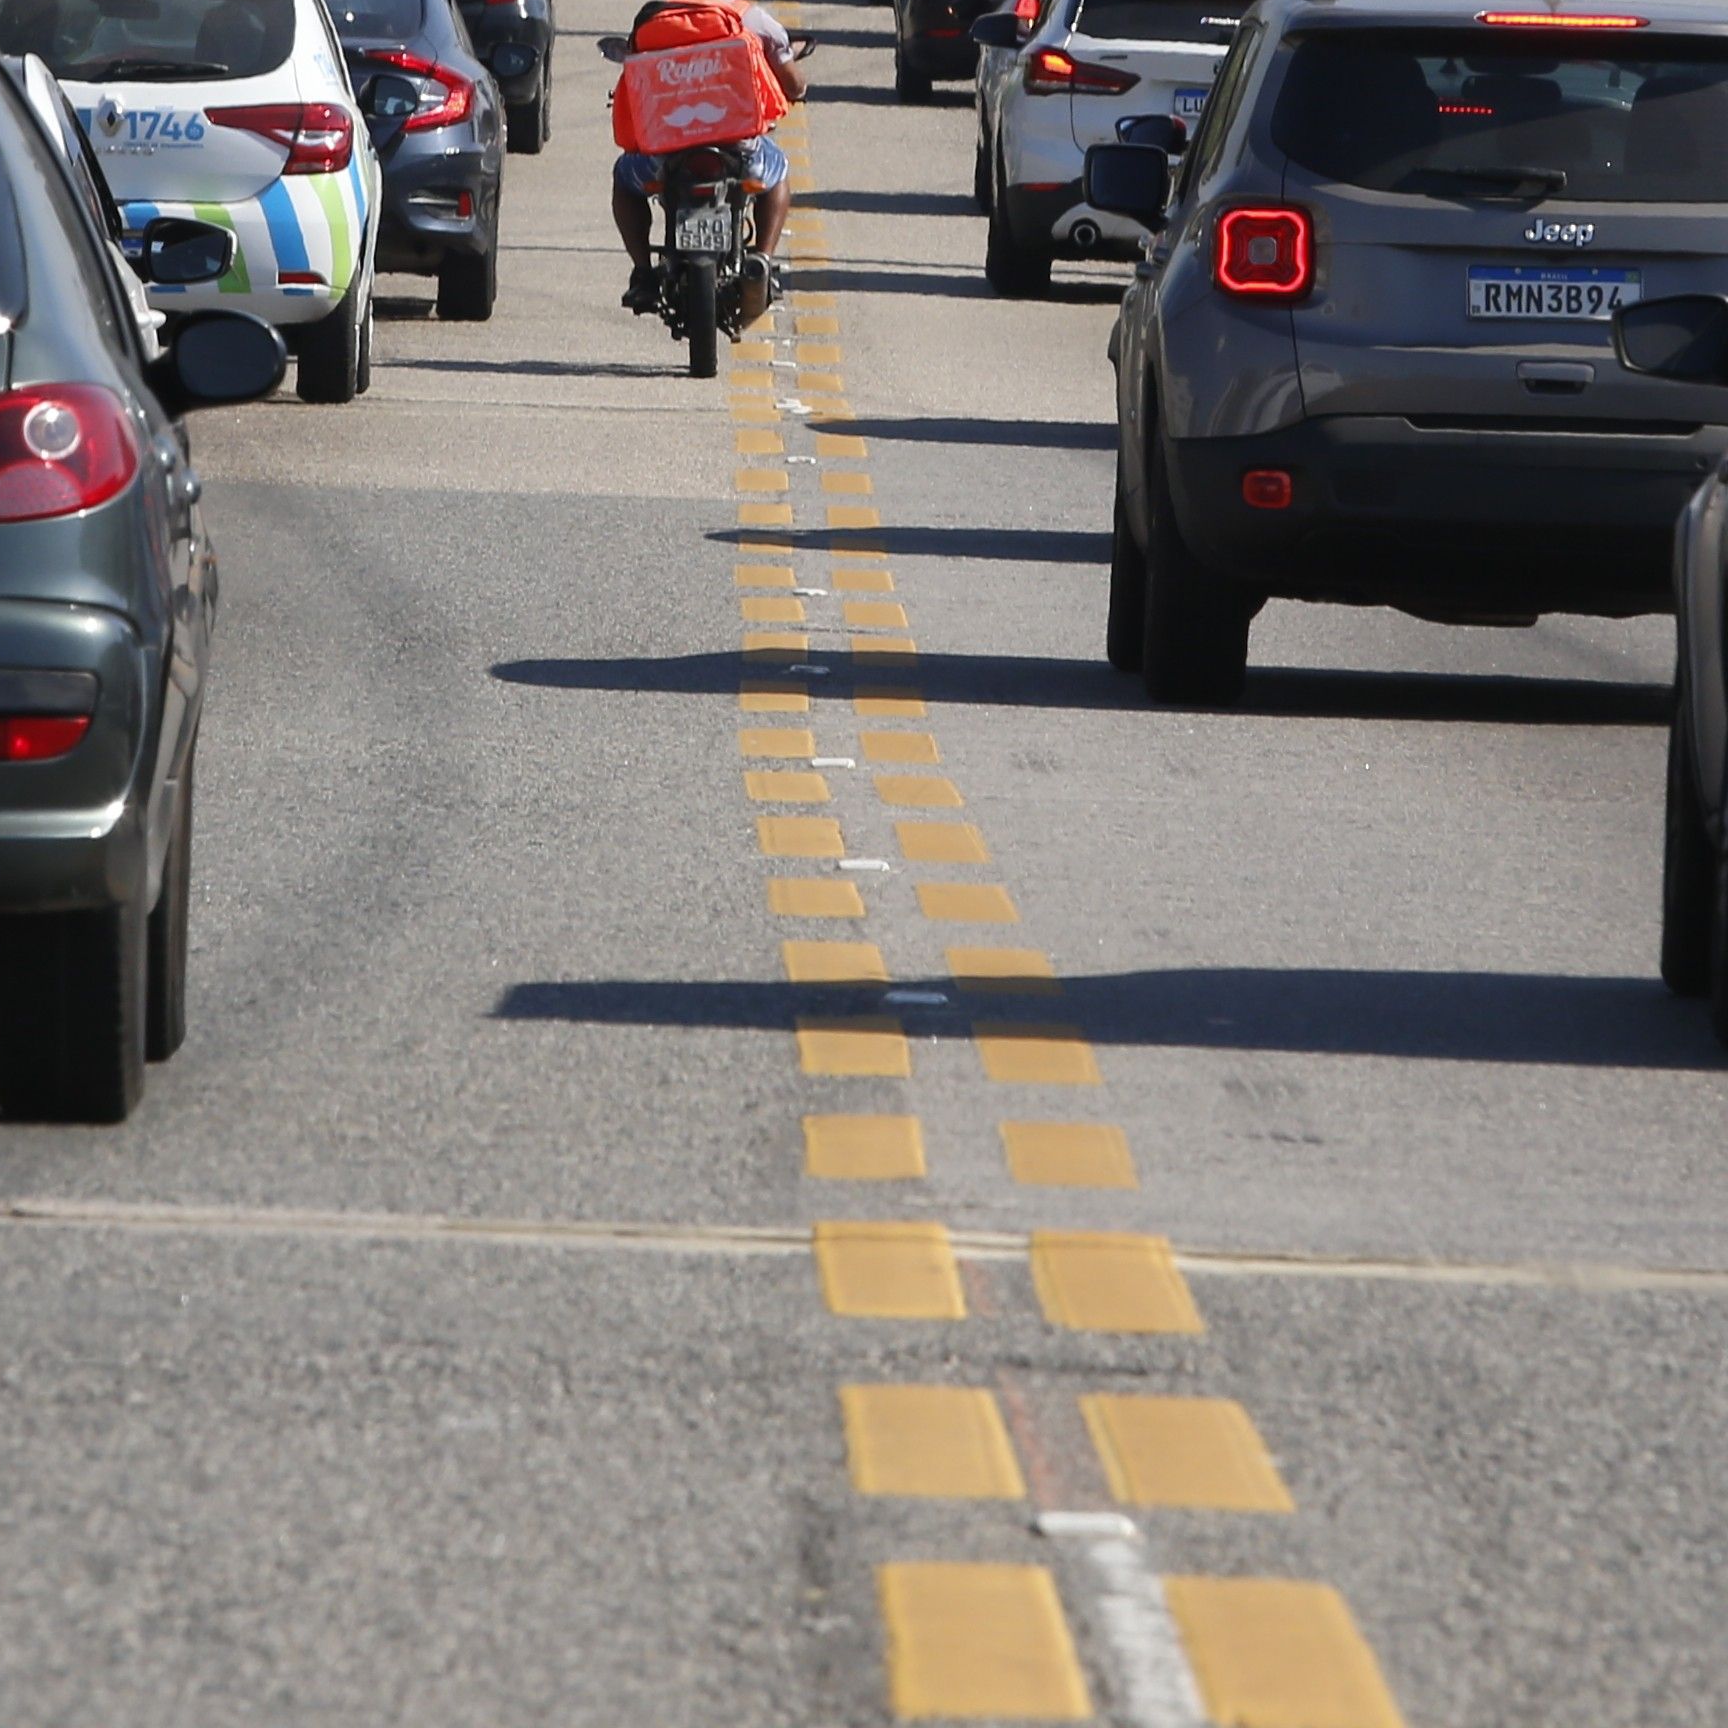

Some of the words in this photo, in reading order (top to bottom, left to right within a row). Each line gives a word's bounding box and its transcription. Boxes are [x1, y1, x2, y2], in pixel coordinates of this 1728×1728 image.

[123, 110, 205, 142] 1746
[1524, 219, 1595, 247] Jeep
[1484, 283, 1622, 315] RMN3B94
